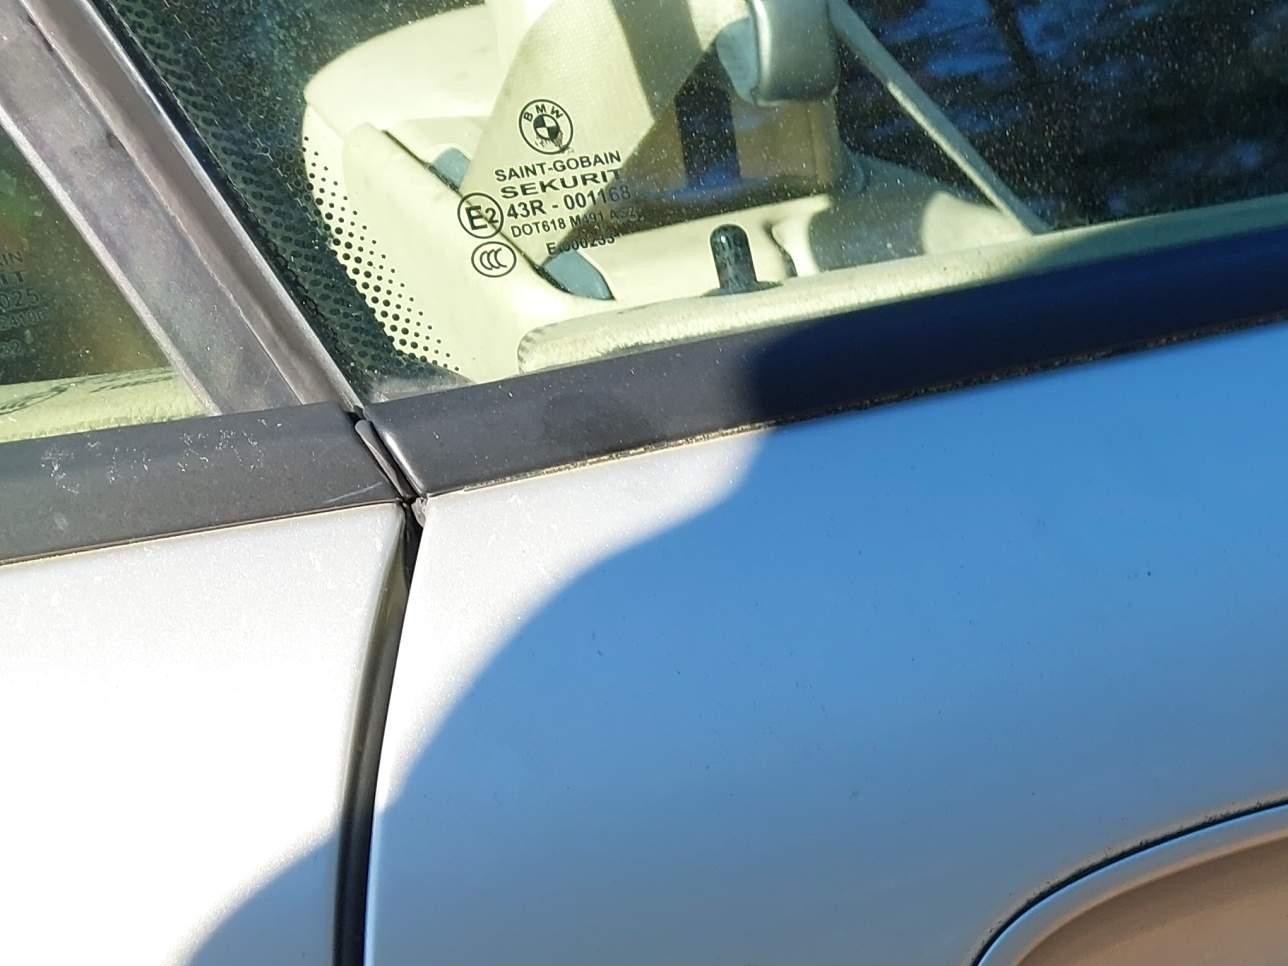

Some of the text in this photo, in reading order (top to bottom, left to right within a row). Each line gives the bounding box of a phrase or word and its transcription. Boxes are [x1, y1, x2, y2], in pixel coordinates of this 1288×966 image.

[523, 104, 564, 122] BMW
[494, 150, 622, 182] SAINT-GOBAIN
[500, 169, 622, 199] SEKURIT
[506, 199, 545, 219] 43R
[563, 185, 632, 212] 001168
[510, 217, 566, 238] DOT618
